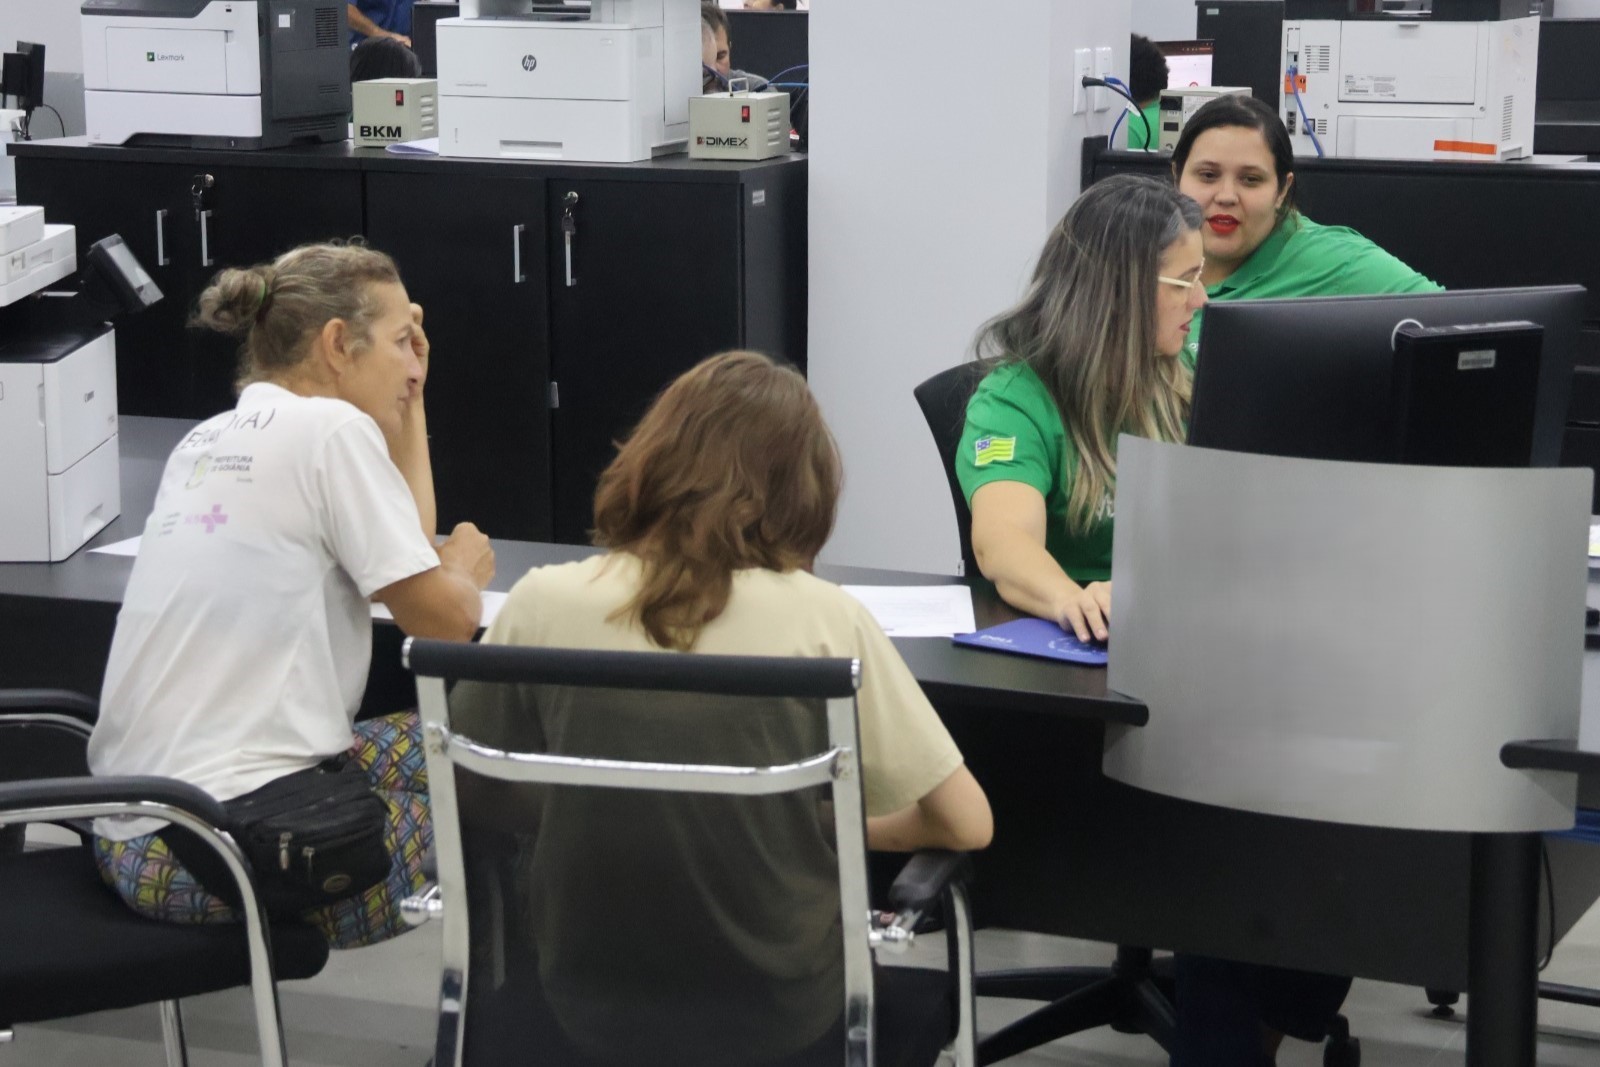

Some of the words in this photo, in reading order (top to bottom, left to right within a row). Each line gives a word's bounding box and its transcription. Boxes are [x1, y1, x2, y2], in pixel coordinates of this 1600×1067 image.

[156, 53, 185, 61] Lexmark
[523, 54, 537, 72] hp
[360, 125, 402, 138] BKM
[706, 136, 748, 146] DIMEX
